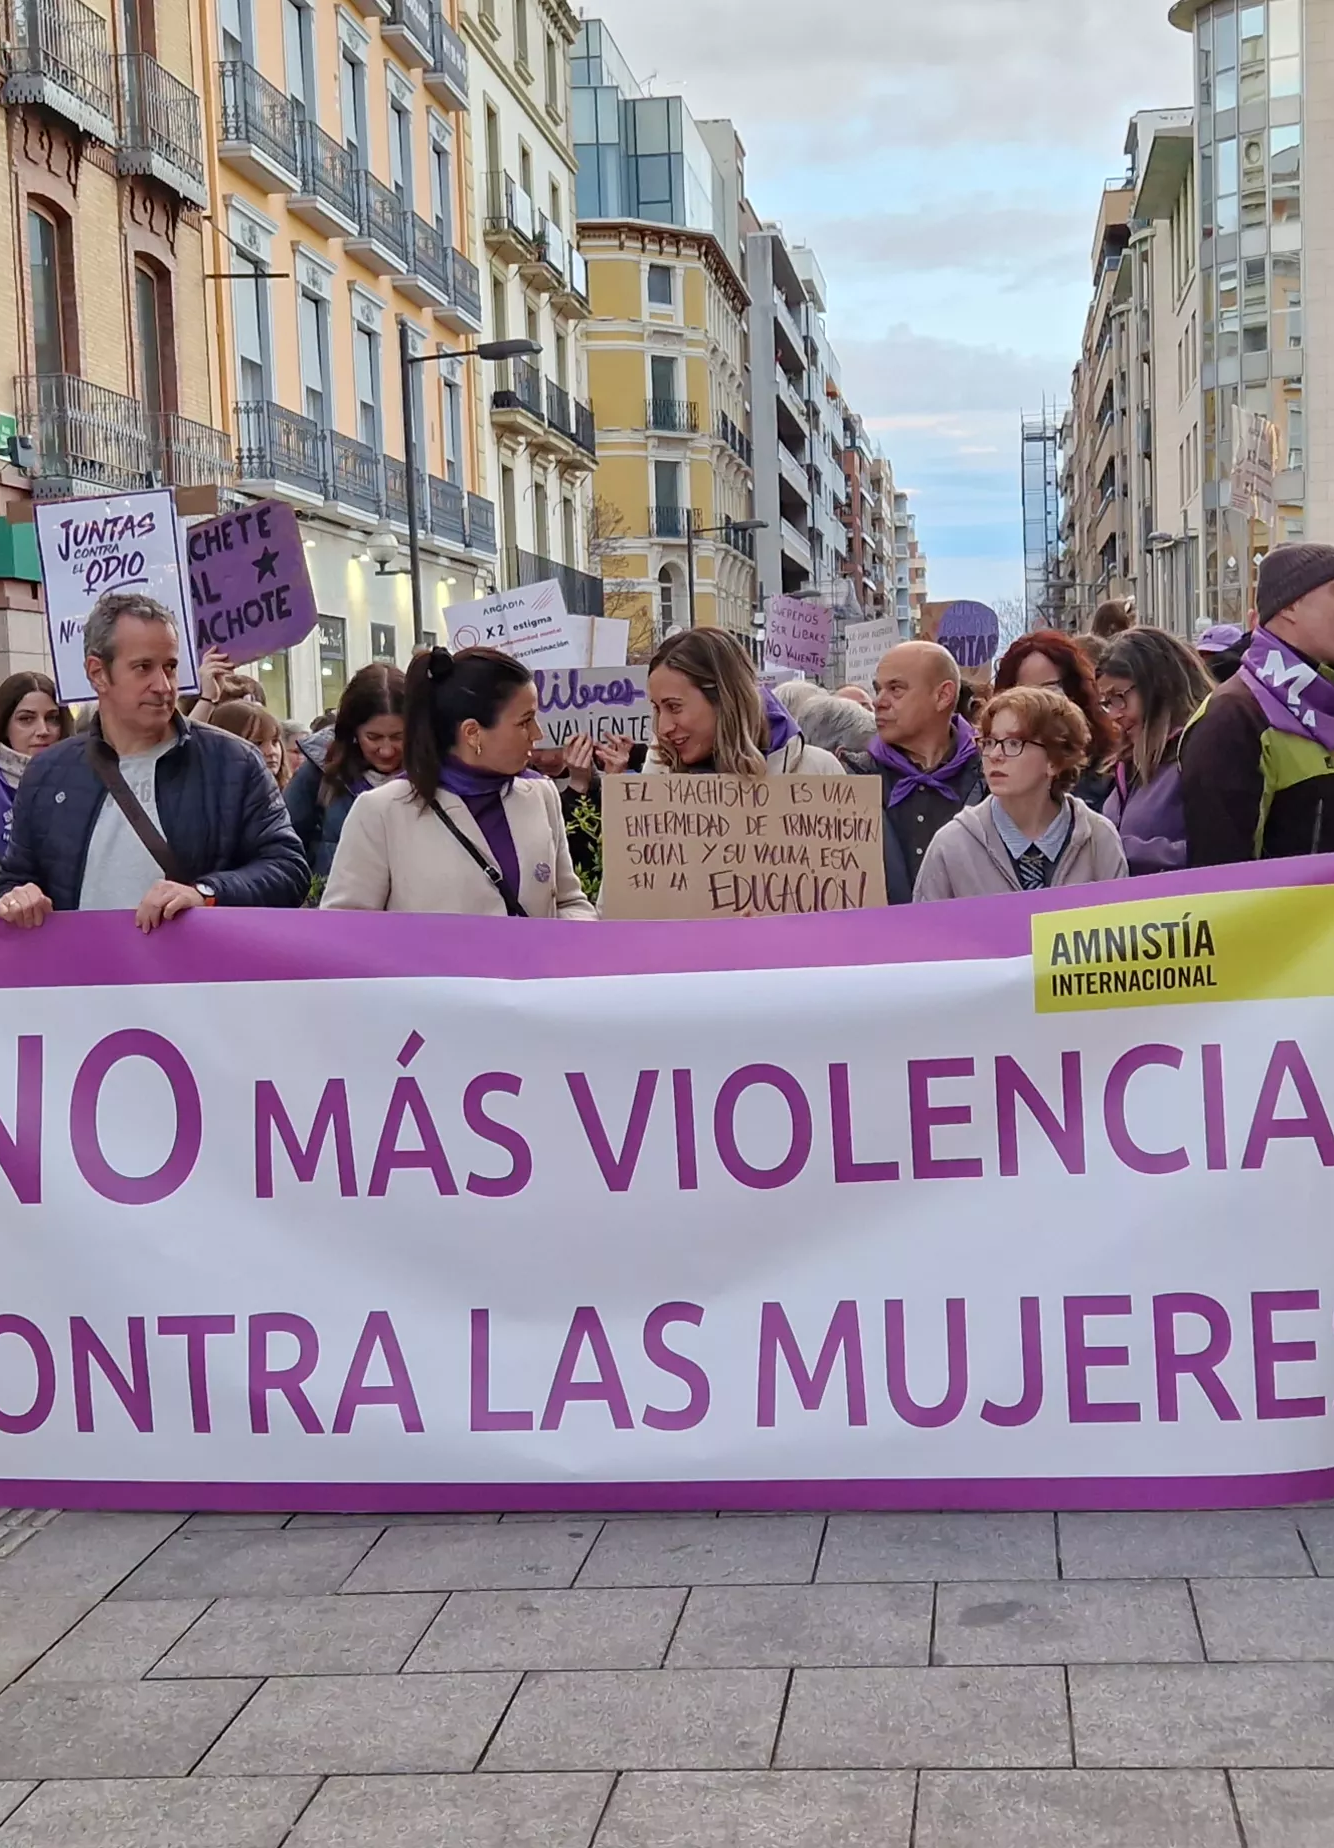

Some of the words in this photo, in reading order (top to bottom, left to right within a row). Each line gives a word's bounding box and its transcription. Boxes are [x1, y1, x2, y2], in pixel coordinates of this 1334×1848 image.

[57, 512, 156, 562] JUNTAS
[188, 506, 272, 565] CHETE
[74, 544, 120, 559] CONTRA
[72, 563, 85, 575] EL
[85, 551, 145, 587] ODIO
[197, 584, 292, 650] ACHOTE
[482, 599, 525, 616] ARCADIA
[60, 620, 77, 644] NI
[513, 615, 552, 632] estigma
[766, 637, 782, 658] NO
[533, 669, 646, 713] libres
[621, 782, 653, 802] EL
[790, 782, 813, 804] ES
[823, 782, 857, 804] UNA
[625, 811, 730, 838] ENFERMEDAD
[746, 815, 768, 836] DE
[701, 843, 718, 864] Y
[723, 843, 747, 865] SU
[754, 843, 811, 868] VACUNA
[820, 844, 859, 871] ESTÁ
[628, 872, 655, 890] EN
[669, 871, 688, 890] LA
[1051, 912, 1216, 966] AMNISTÍA
[1052, 965, 1217, 997] INTERNACIONAL
[255, 1030, 534, 1198] MÁS
[470, 1302, 711, 1432] LAS
